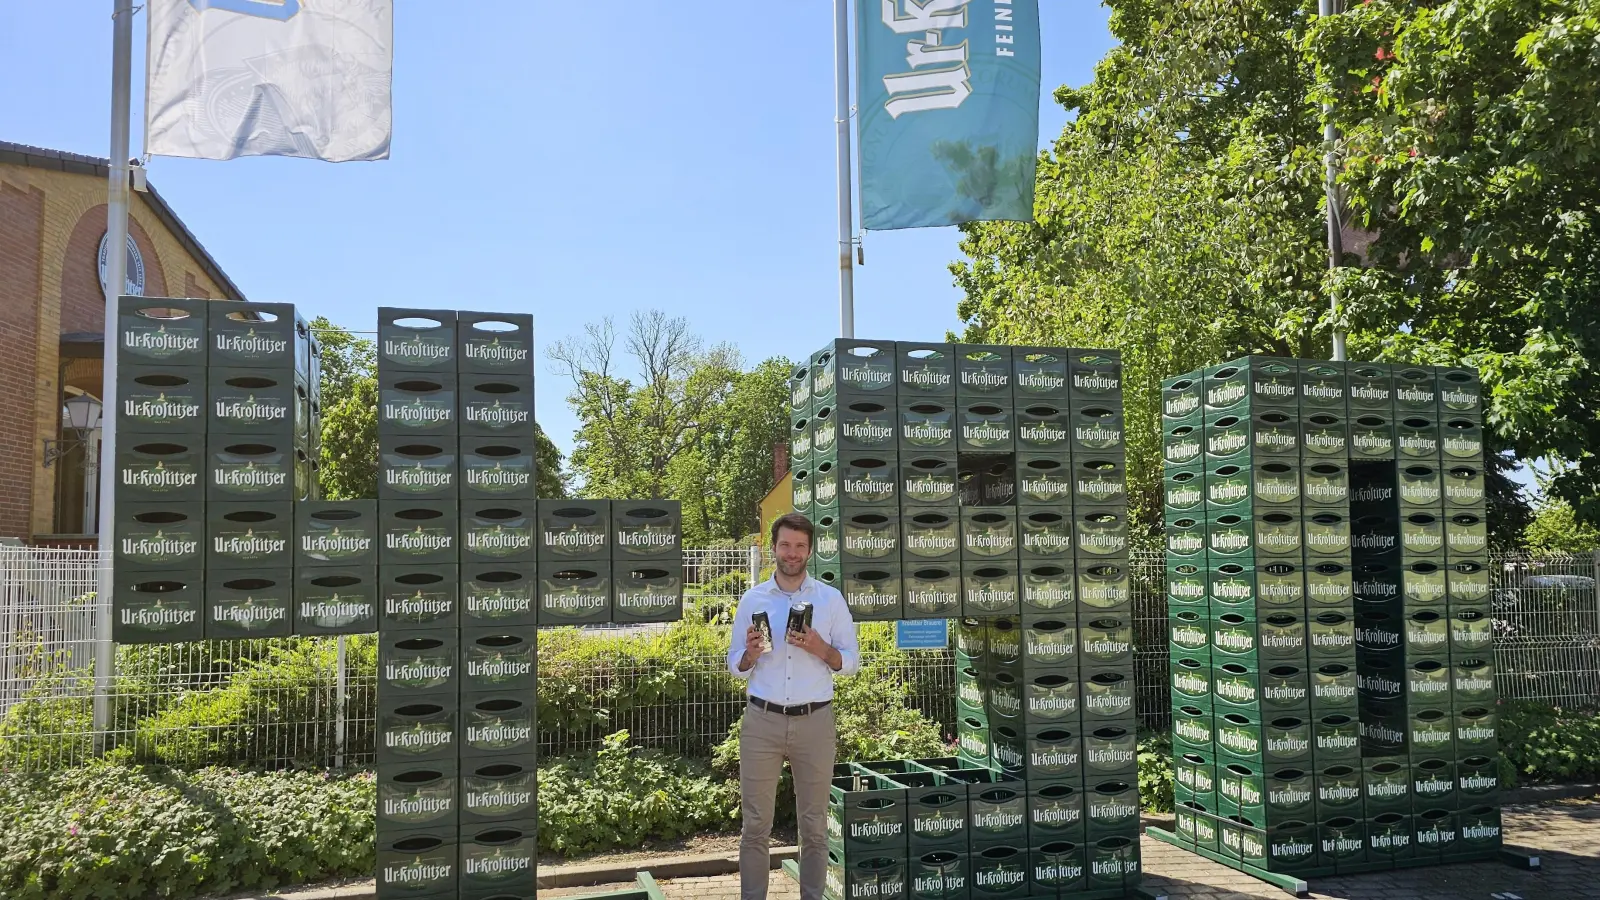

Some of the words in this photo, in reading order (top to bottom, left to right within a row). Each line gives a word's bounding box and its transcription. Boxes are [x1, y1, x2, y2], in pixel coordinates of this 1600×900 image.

[125, 330, 199, 350] Ur-Krostitzer
[216, 335, 287, 353] Ur-Krostitzer
[385, 340, 450, 359] Ur-Krostitzer
[465, 342, 527, 360] Ur-Krostitzer
[842, 368, 891, 385] Ur-Krostitzer
[902, 370, 951, 387] Ur-Krostitzer
[961, 373, 1008, 388] Ur-Krostitzer
[1019, 374, 1064, 389] Ur-Krostitzer
[1074, 375, 1118, 392] Ur-Krostitzer
[1255, 382, 1295, 397] Ur-Krostitzer
[1303, 384, 1342, 398] Ur-Krostitzer
[1351, 386, 1389, 399] Ur-Krostitzer
[1397, 388, 1434, 402] Ur-Krostitzer
[1442, 391, 1478, 405] Ur-Krostitzer
[125, 398, 199, 418] Ur-Krostitzer
[216, 402, 287, 419] Ur-Krostitzer
[385, 403, 451, 421] Ur-Krostitzer
[466, 405, 528, 423] Ur-Krostitzer
[843, 425, 892, 441] Ur-Krostitzer
[904, 427, 952, 442] Ur-Krostitzer
[963, 427, 1010, 443] Ur-Krostitzer
[1020, 428, 1066, 443] Ur-Krostitzer
[1076, 428, 1120, 444] Ur-Krostitzer
[1256, 432, 1295, 446] Ur-Krostitzer
[1306, 434, 1344, 448] Ur-Krostitzer
[1353, 435, 1391, 448] Ur-Krostitzer
[1399, 436, 1436, 450] Ur-Krostitzer
[1444, 438, 1479, 451] Ur-Krostitzer
[123, 468, 197, 487] Ur-Krostitzer
[215, 468, 286, 486] Ur-Krostitzer
[386, 468, 451, 485] Ur-Krostitzer
[467, 468, 529, 486] Ur-Krostitzer
[844, 480, 894, 495] Ur-Krostitzer
[906, 480, 954, 496] Ur-Krostitzer
[1022, 479, 1068, 495] Ur-Krostitzer
[1079, 481, 1122, 496] Ur-Krostitzer
[1257, 483, 1297, 498] Ur-Krostitzer
[1307, 484, 1346, 498] Ur-Krostitzer
[1401, 485, 1439, 499] Ur-Krostitzer
[1446, 485, 1482, 499] Ur-Krostitzer
[214, 535, 285, 553] Ur-Krostitzer
[302, 533, 370, 551] Ur-Krostitzer
[386, 532, 452, 549] Ur-Krostitzer
[468, 532, 530, 549] Ur-Krostitzer
[545, 530, 604, 547] Ur-Krostitzer
[618, 530, 676, 546] Ur-Krostitzer
[846, 535, 895, 551] Ur-Krostitzer
[907, 536, 955, 552] Ur-Krostitzer
[966, 535, 1013, 550] Ur-Krostitzer
[1024, 534, 1069, 549] Ur-Krostitzer
[1080, 535, 1124, 549] Ur-Krostitzer
[1258, 533, 1298, 547] Ur-Krostitzer
[1308, 533, 1347, 547] Ur-Krostitzer
[1352, 534, 1394, 550] Ur-Krostitzer
[1404, 534, 1441, 547] Ur-Krostitzer
[1449, 533, 1484, 546] Ur-Krostitzer
[122, 538, 197, 556] Ur-Krostitzer
[1082, 587, 1126, 602] Ur-Krostitzer
[1260, 582, 1300, 596] Ur-Krostitzer
[1310, 582, 1349, 596] Ur-Krostitzer
[1353, 582, 1396, 596] Ur-Krostitzer
[1406, 582, 1443, 595] Ur-Krostitzer
[1451, 581, 1486, 594] Ur-Krostitzer
[545, 592, 605, 609] Ur-Krostitzer
[619, 590, 677, 608] Ur-Krostitzer
[848, 592, 897, 608] Ur-Krostitzer
[909, 592, 957, 607] Ur-Krostitzer
[968, 590, 1014, 605] Ur-Krostitzer
[1025, 588, 1071, 603] Ur-Krostitzer
[301, 600, 370, 618] Ur-Krostitzer
[386, 595, 452, 615] Ur-Krostitzer
[468, 594, 530, 613] Ur-Krostitzer
[121, 606, 196, 625] Ur-Krostitzer
[213, 603, 285, 622] Ur-Krostitzer
[1262, 634, 1302, 648] Ur-Krostitzer
[1313, 634, 1352, 648] Ur-Krostitzer
[1355, 628, 1399, 645] Ur-Krostitzer
[1408, 631, 1445, 645] Ur-Krostitzer
[1453, 630, 1490, 642] Ur-Krostitzer
[1028, 643, 1073, 657] Ur-Krostitzer
[1084, 641, 1128, 655] Ur-Krostitzer
[386, 665, 451, 681] Ur-Krostitzer
[468, 662, 530, 678] Ur-Krostitzer
[1315, 685, 1354, 699] Ur-Krostitzer
[1357, 675, 1400, 694] Ur-Krostitzer
[1410, 680, 1447, 693] Ur-Krostitzer
[1456, 678, 1491, 691] Ur-Krostitzer
[1264, 687, 1305, 699] Ur-Krostitzer
[1029, 698, 1075, 711] Ur-Krostitzer
[1086, 695, 1131, 709] Ur-Krostitzer
[386, 730, 452, 748] Ur-Krostitzer
[468, 726, 530, 742] Ur-Krostitzer
[1359, 723, 1403, 742] Ur-Krostitzer
[1413, 729, 1450, 743] Ur-Krostitzer
[1458, 728, 1494, 741] Ur-Krostitzer
[1267, 739, 1308, 752] Ur-Krostitzer
[1317, 736, 1357, 749] Ur-Krostitzer
[1031, 752, 1077, 767] Ur-Krostitzer
[1088, 749, 1133, 763] Ur-Krostitzer
[1368, 783, 1407, 796] Ur-Krostitzer
[1415, 779, 1452, 793] Ur-Krostitzer
[1460, 777, 1496, 789] Ur-Krostitzer
[467, 791, 530, 808] Ur-Krostitzer
[1270, 790, 1310, 804] Ur-Krostitzer
[1320, 786, 1359, 800] Ur-Krostitzer
[385, 797, 451, 815] Ur-Krostitzer
[1090, 805, 1135, 820] Ur-Krostitzer
[975, 814, 1022, 829] Ur-Krostitzer
[1033, 809, 1079, 824] Ur-Krostitzer
[851, 822, 902, 838] Ur-Krostitzer
[914, 819, 964, 834] Ur-Krostitzer
[1463, 826, 1499, 839] Ur-Krostitzer
[1271, 843, 1313, 856] Ur-Krostitzer
[466, 856, 530, 874] Ur-Krostitzer
[384, 863, 451, 883] Ur-Krostitzer
[977, 871, 1025, 886] Ur-Krostitzer
